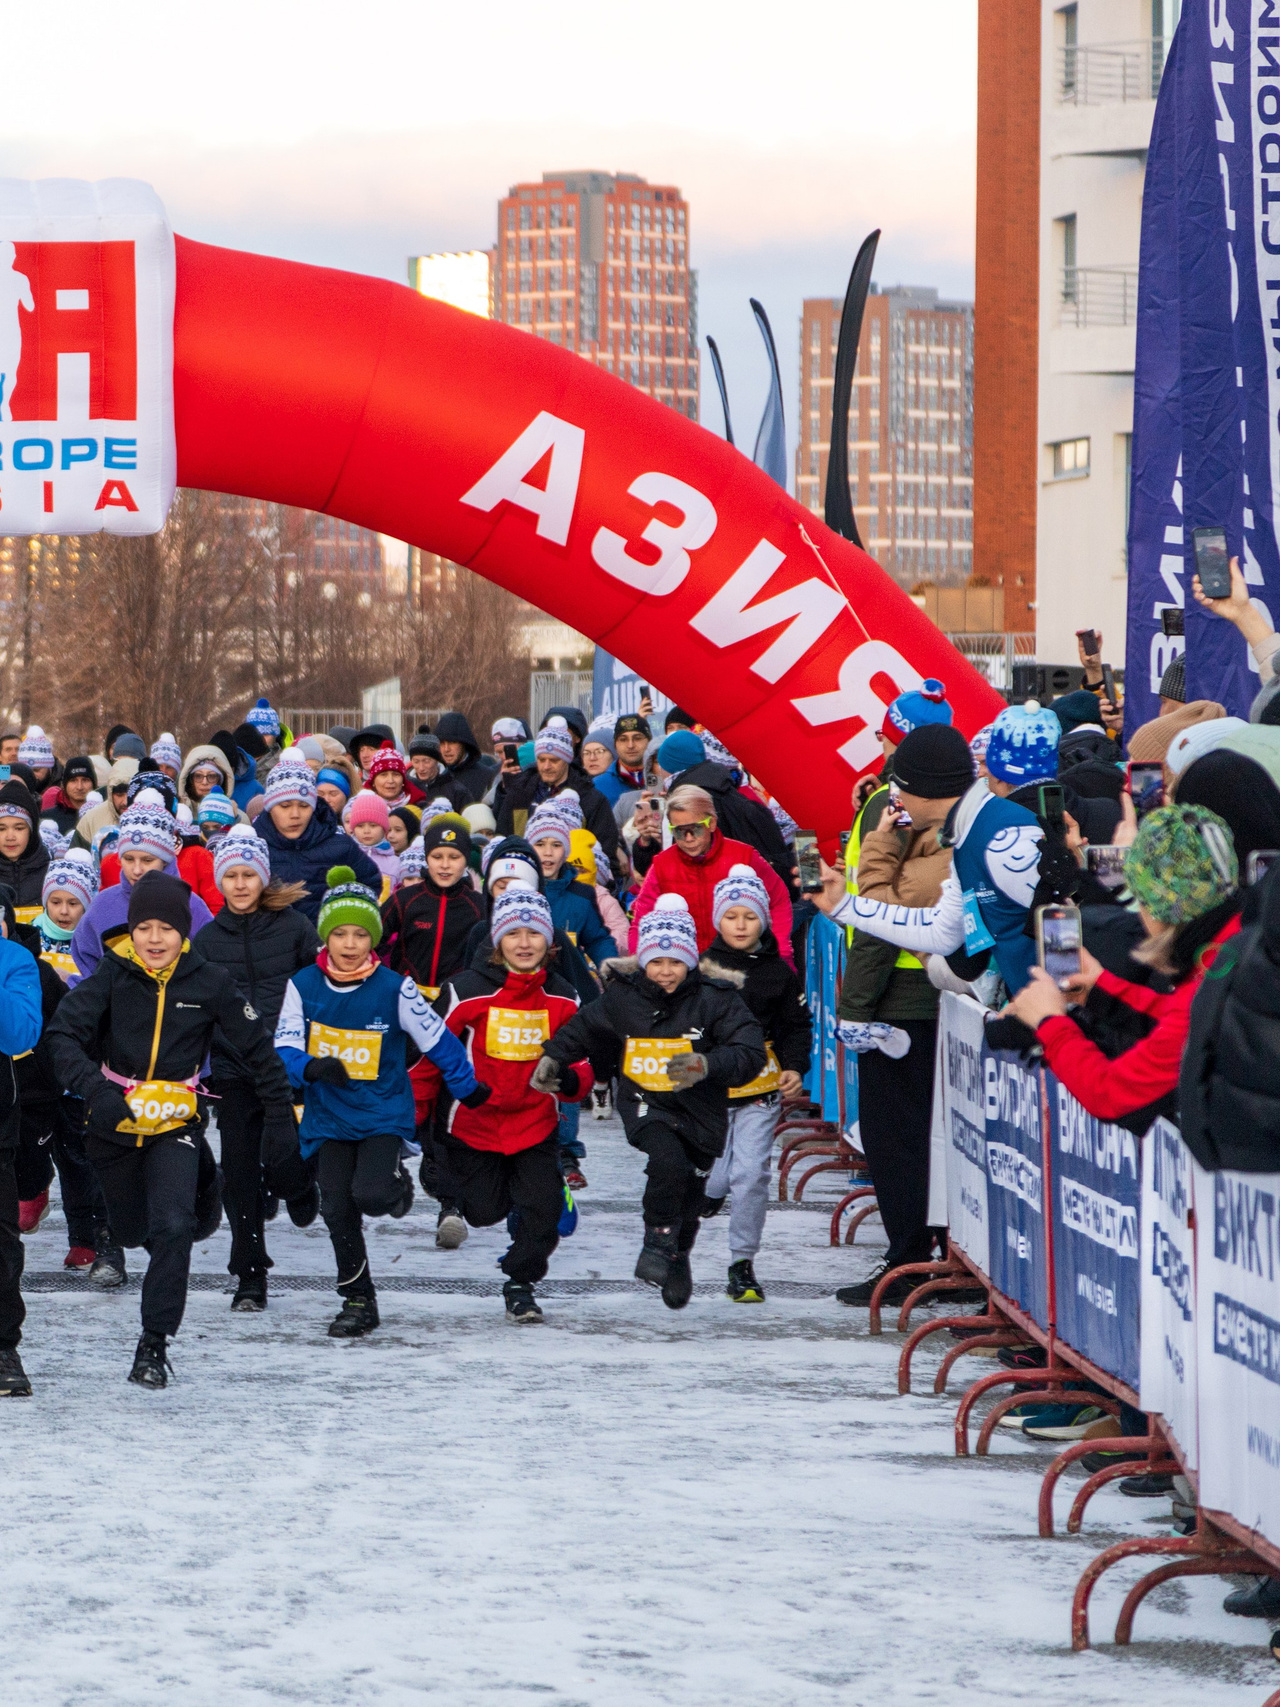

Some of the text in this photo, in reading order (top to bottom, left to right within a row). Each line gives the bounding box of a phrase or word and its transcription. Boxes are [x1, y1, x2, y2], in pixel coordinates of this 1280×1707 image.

[460, 410, 930, 773] АЗИЯ
[497, 1026, 543, 1045] 5132
[317, 1041, 371, 1064] 5140
[631, 1057, 671, 1075] 502
